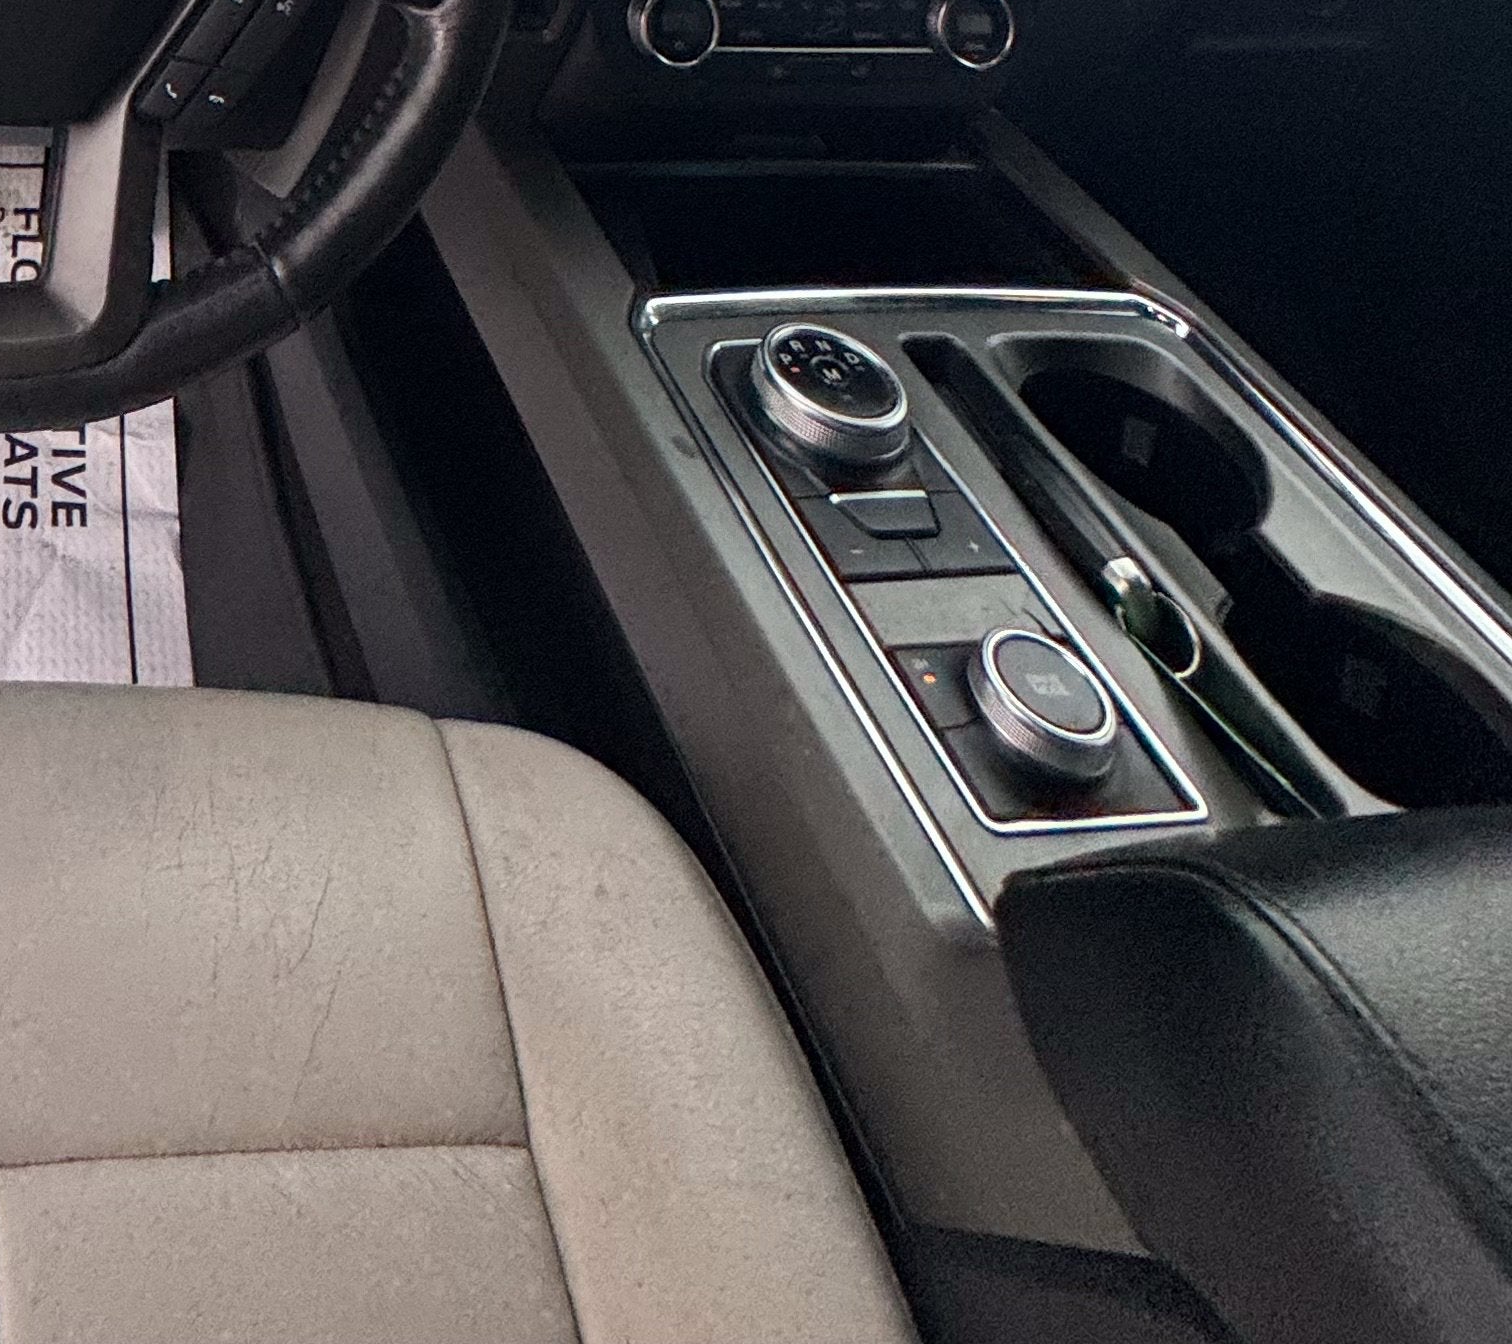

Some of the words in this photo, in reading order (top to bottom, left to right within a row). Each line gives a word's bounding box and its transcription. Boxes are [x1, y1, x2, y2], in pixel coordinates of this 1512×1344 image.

[11, 208, 42, 284] FLO
[789, 340, 805, 352] R
[778, 352, 793, 365] P
[843, 352, 860, 365] D
[2, 432, 39, 530] ATS
